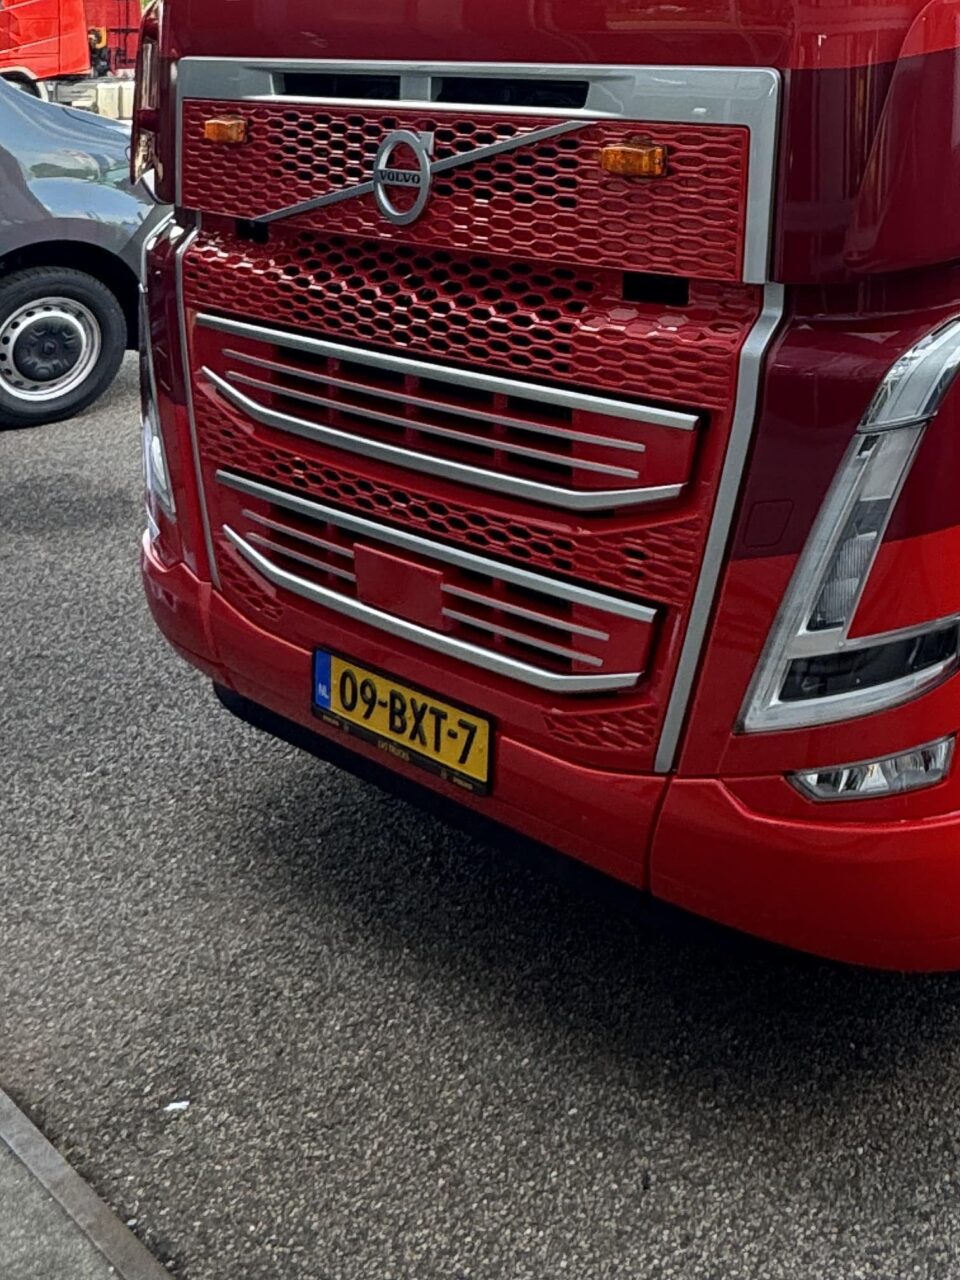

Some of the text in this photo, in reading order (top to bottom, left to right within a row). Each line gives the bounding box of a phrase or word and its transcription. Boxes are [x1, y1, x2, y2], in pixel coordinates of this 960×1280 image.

[380, 170, 421, 184] VOLVO
[318, 683, 330, 699] NL
[339, 668, 478, 765] 09-BXT-7
